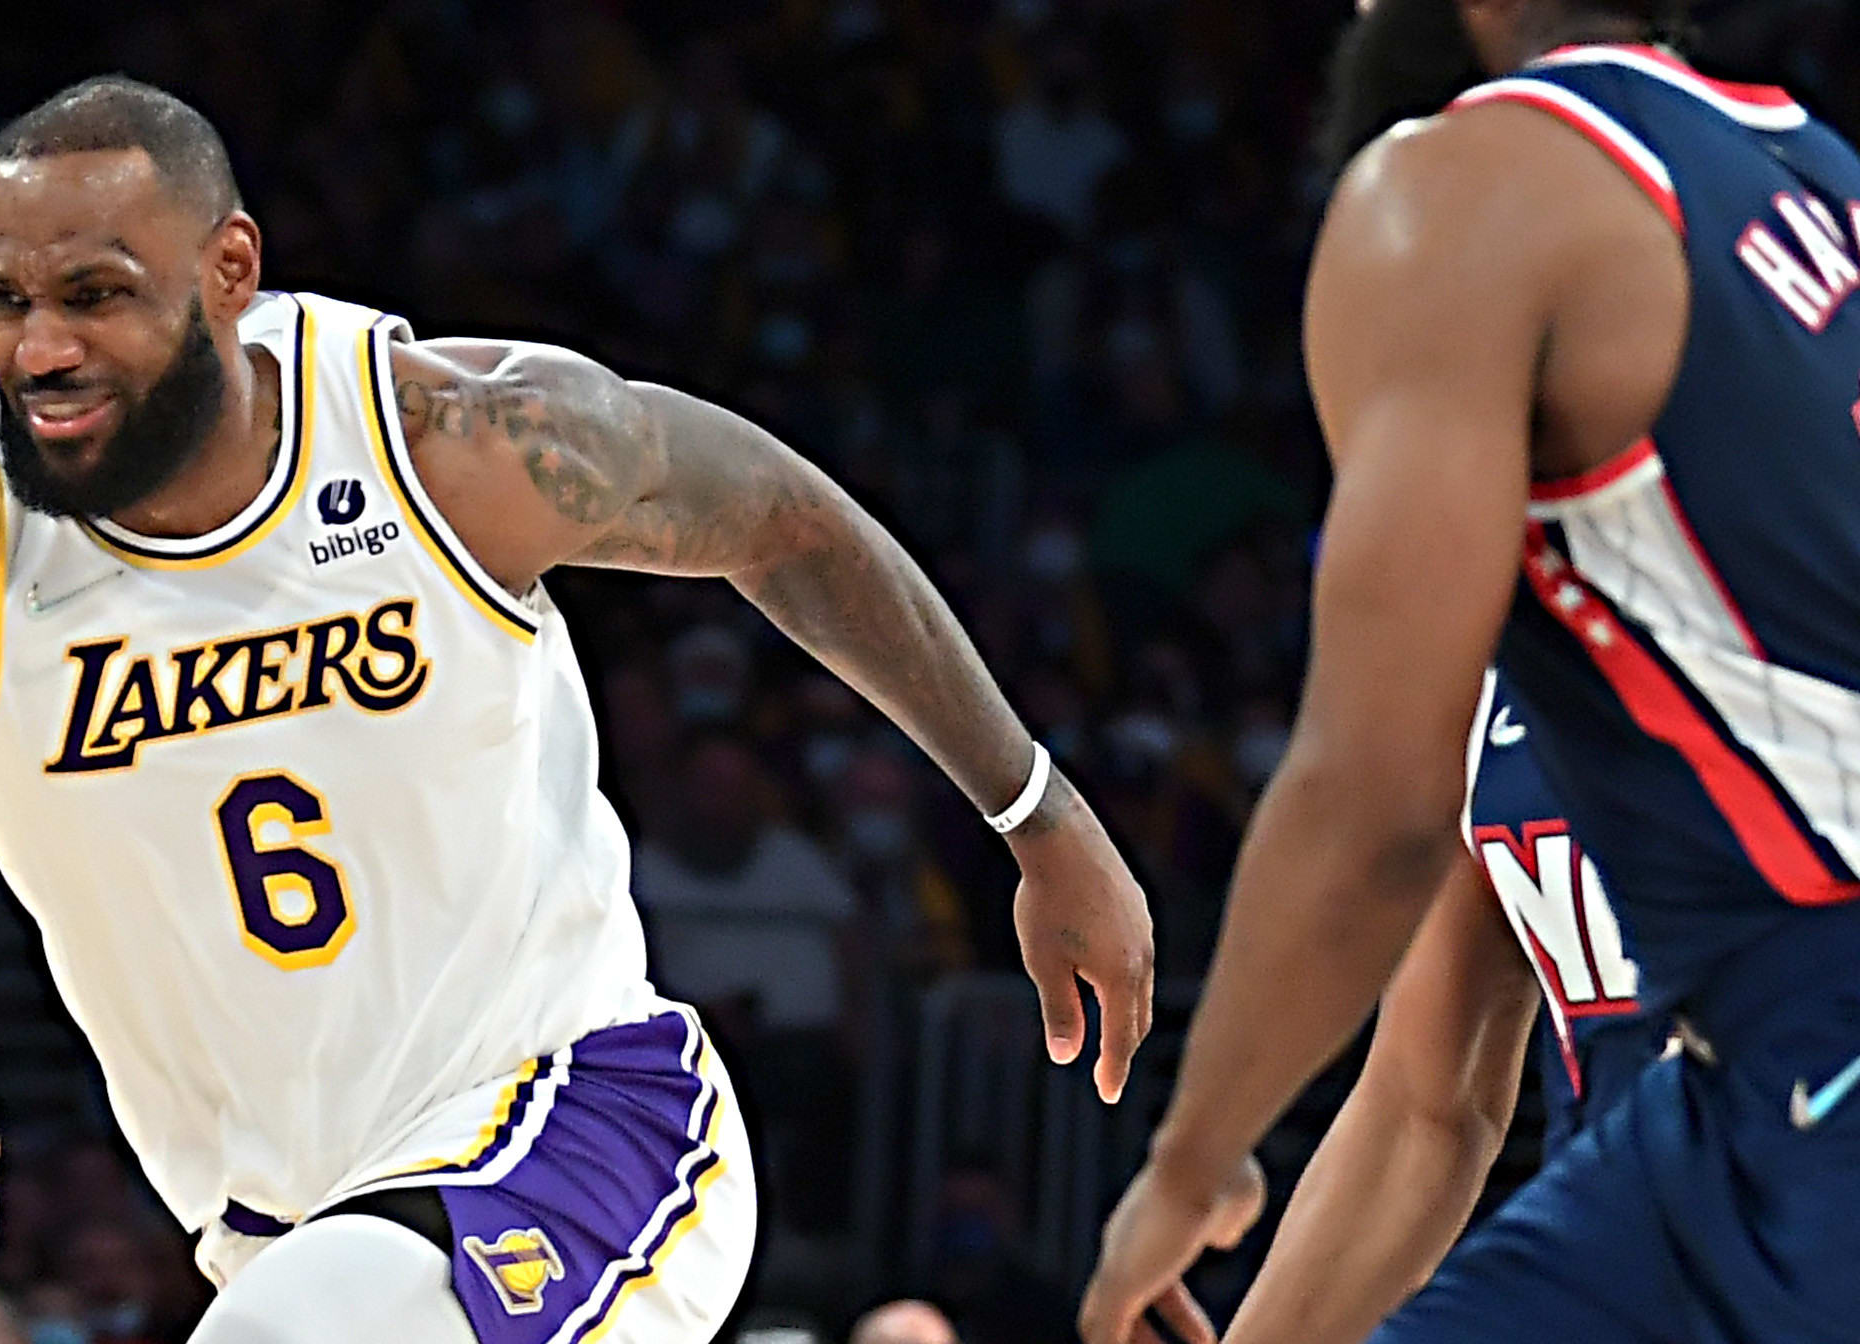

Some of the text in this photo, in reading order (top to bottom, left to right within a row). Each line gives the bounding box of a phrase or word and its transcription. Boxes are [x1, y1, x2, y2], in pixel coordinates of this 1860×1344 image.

[308, 520, 400, 566] bibigo
[42, 596, 434, 777] LAKERS
[211, 768, 357, 971] 6
